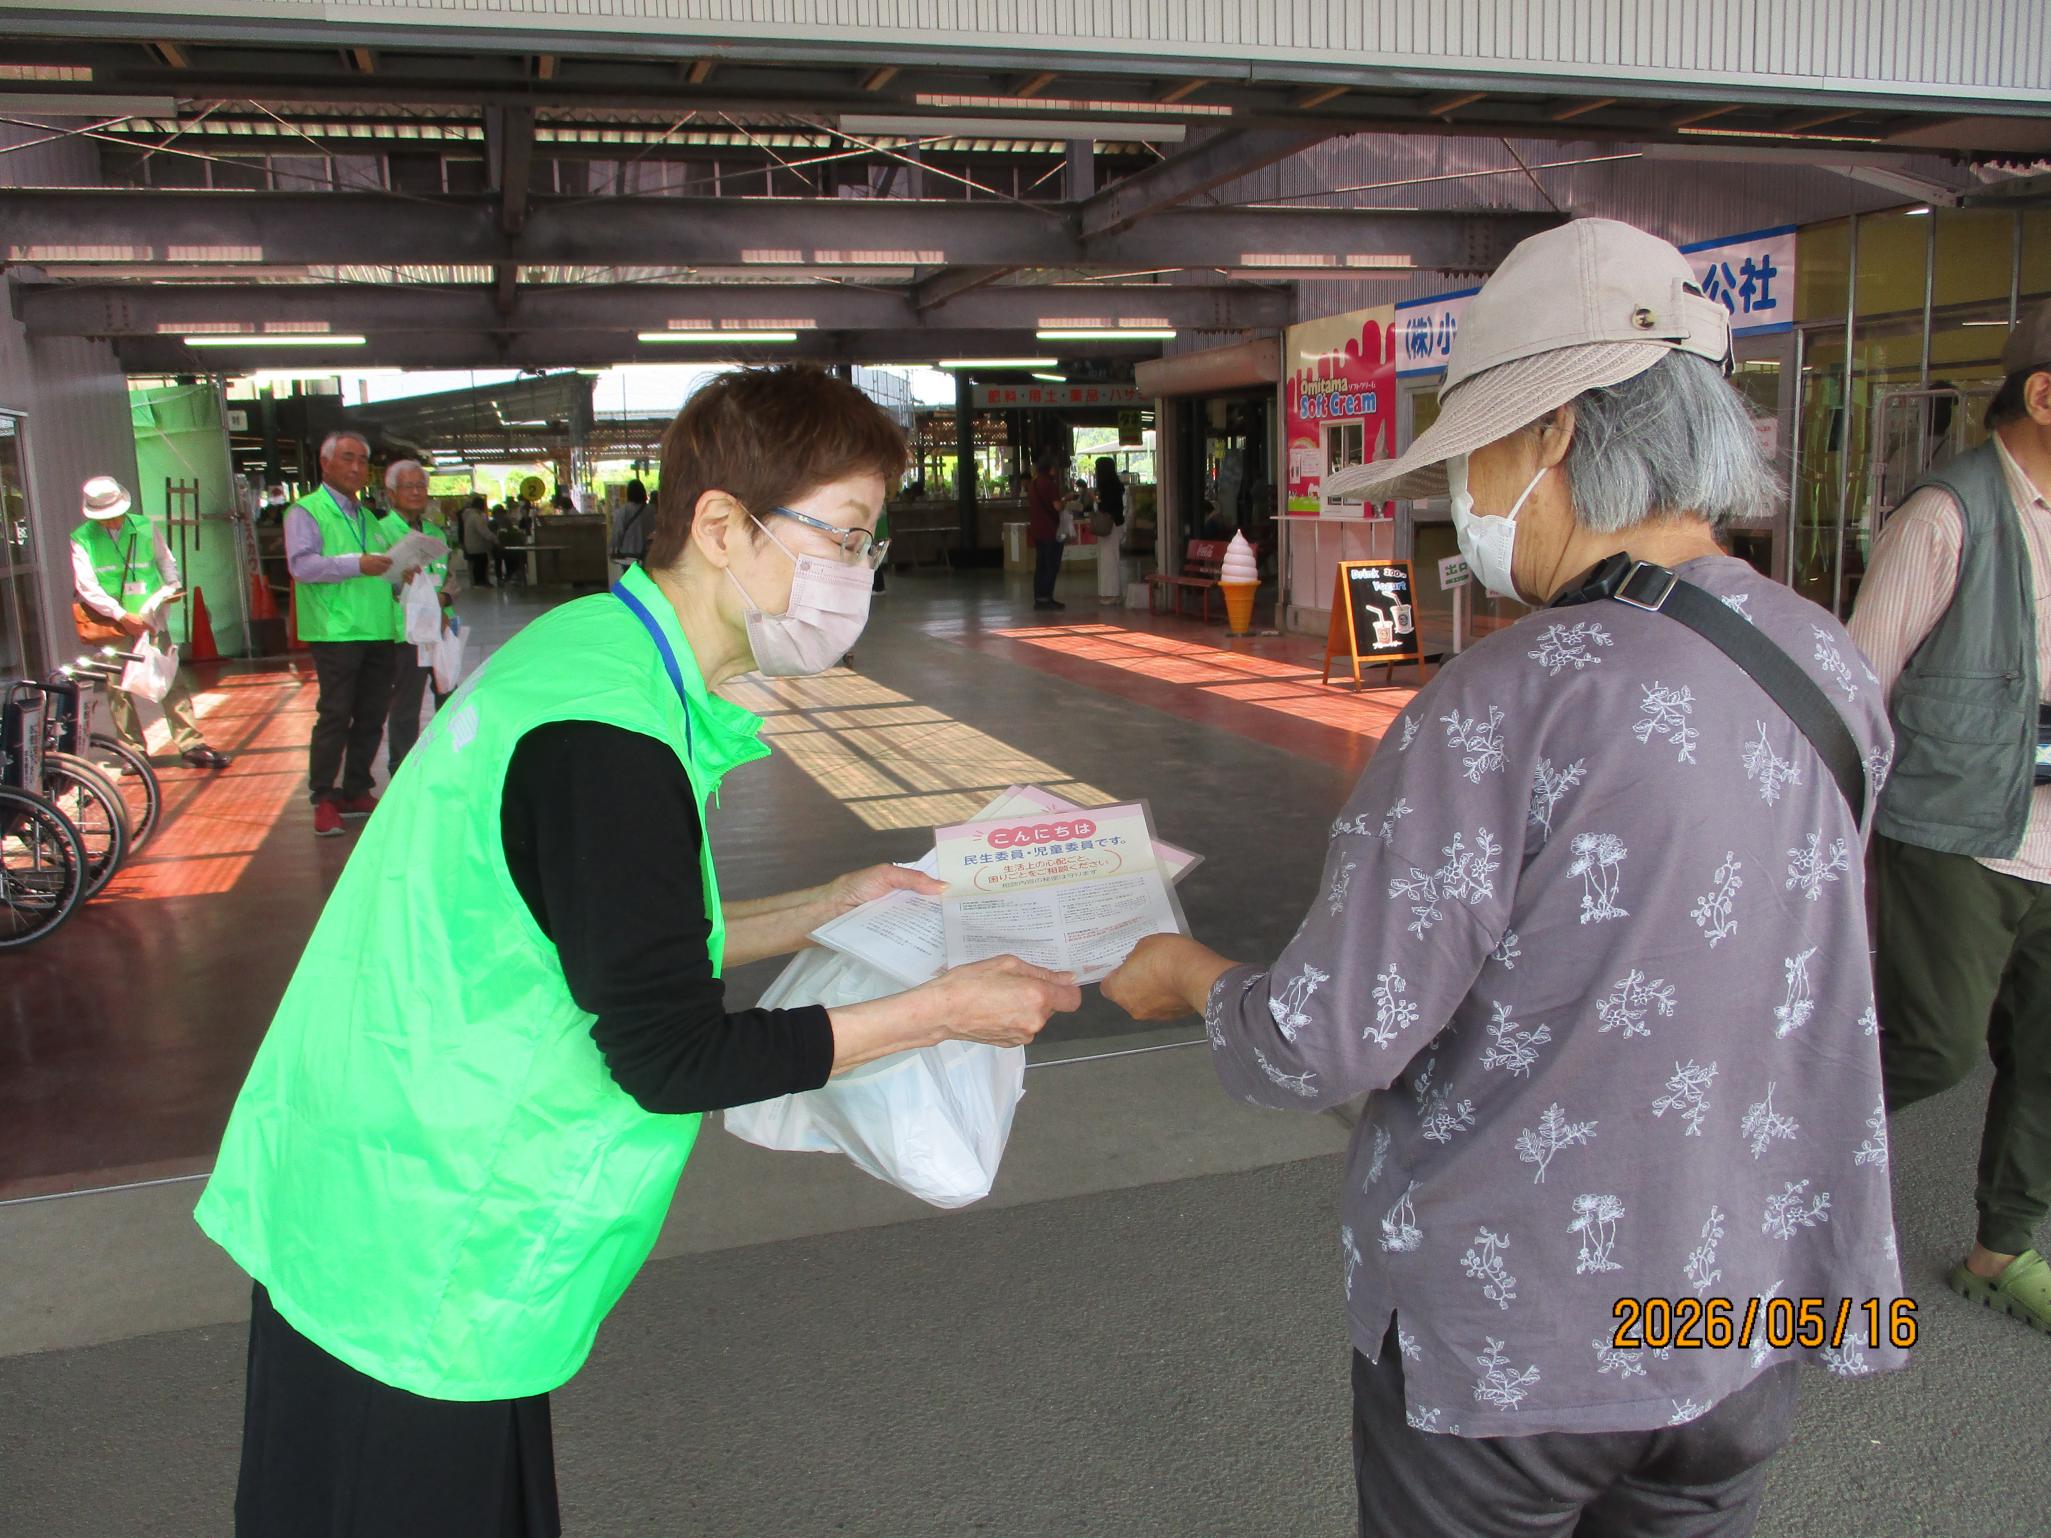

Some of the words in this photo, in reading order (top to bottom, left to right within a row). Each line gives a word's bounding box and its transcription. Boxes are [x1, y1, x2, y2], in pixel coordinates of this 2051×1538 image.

[1702, 254, 1777, 315] 公社
[1300, 393, 1328, 419] Soft
[1329, 391, 1376, 416] Cream
[1445, 562, 1468, 576] 出口
[1372, 581, 1407, 592] Yogurt
[994, 822, 1091, 845] こんにちは
[964, 836, 1126, 866] 民生委員・児童委員です。
